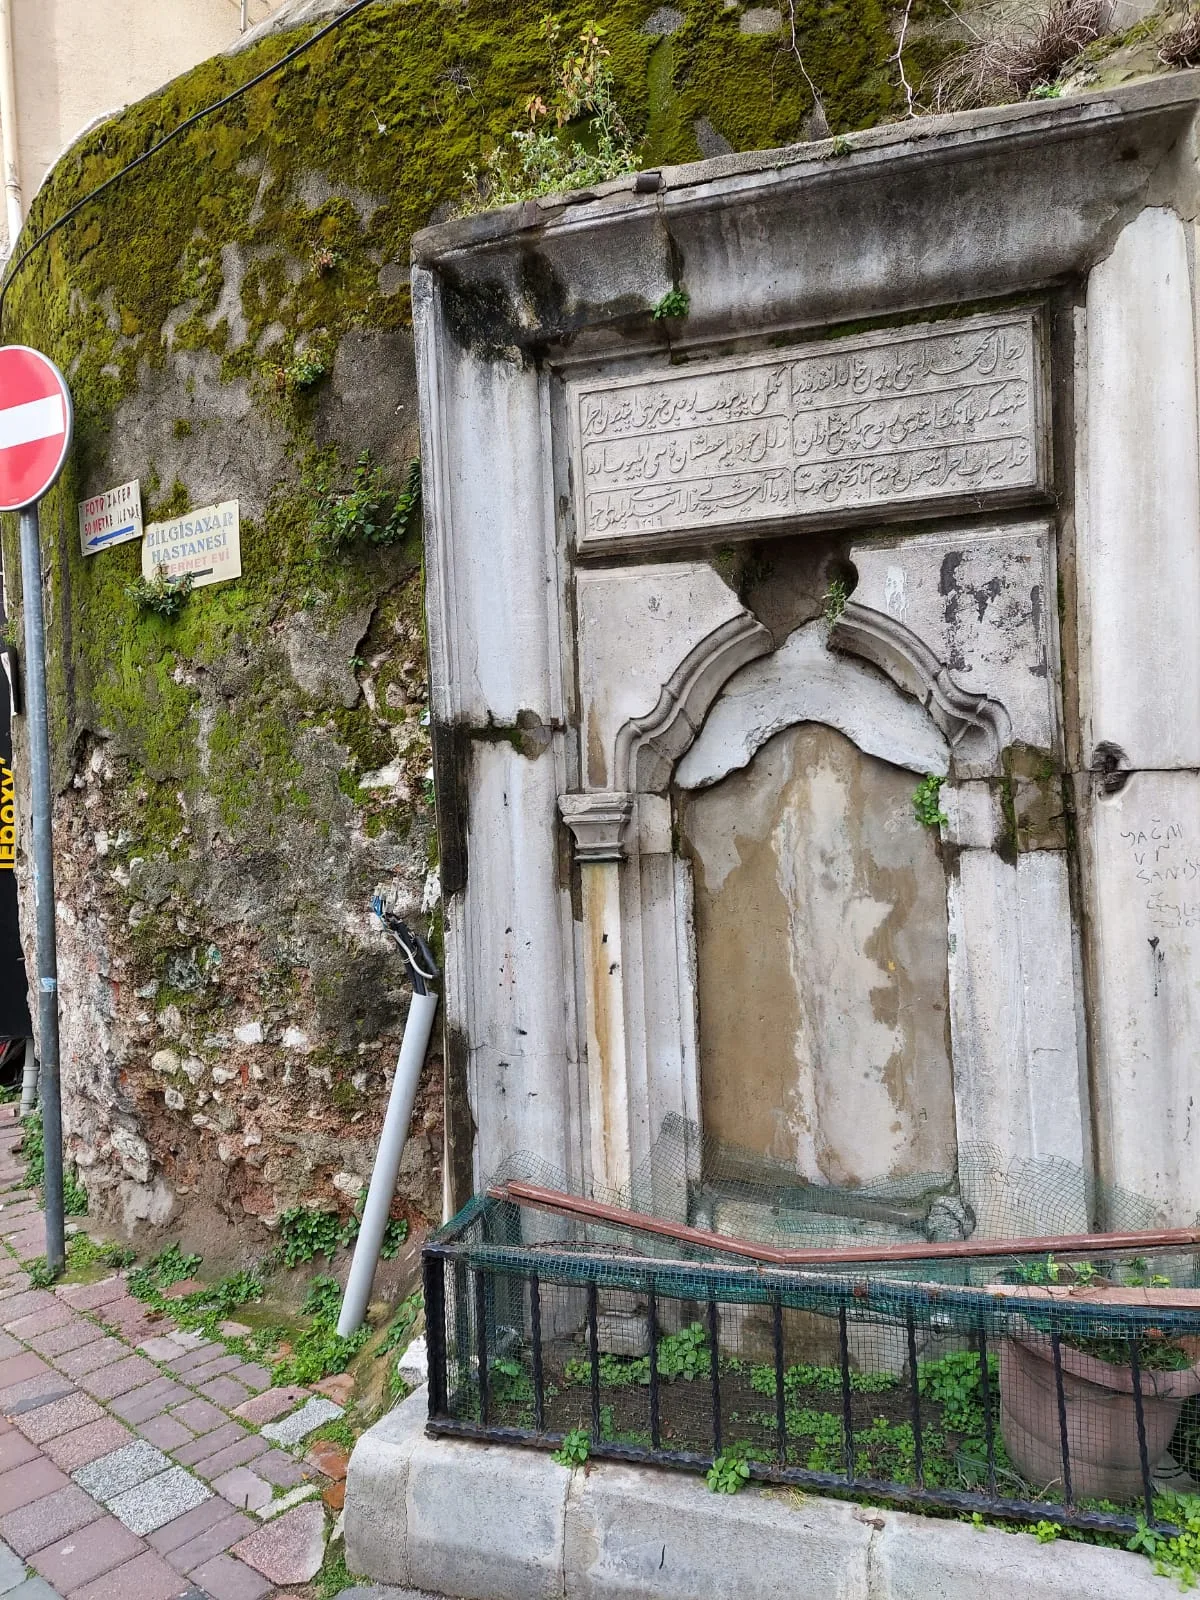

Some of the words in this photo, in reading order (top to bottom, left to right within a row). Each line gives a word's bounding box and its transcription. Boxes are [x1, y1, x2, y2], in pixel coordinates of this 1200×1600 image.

[85, 498, 105, 517] FOTO
[147, 511, 233, 547] BİLGİSAYAR
[152, 529, 227, 563] HASTANESİ
[211, 548, 230, 564] EVİ
